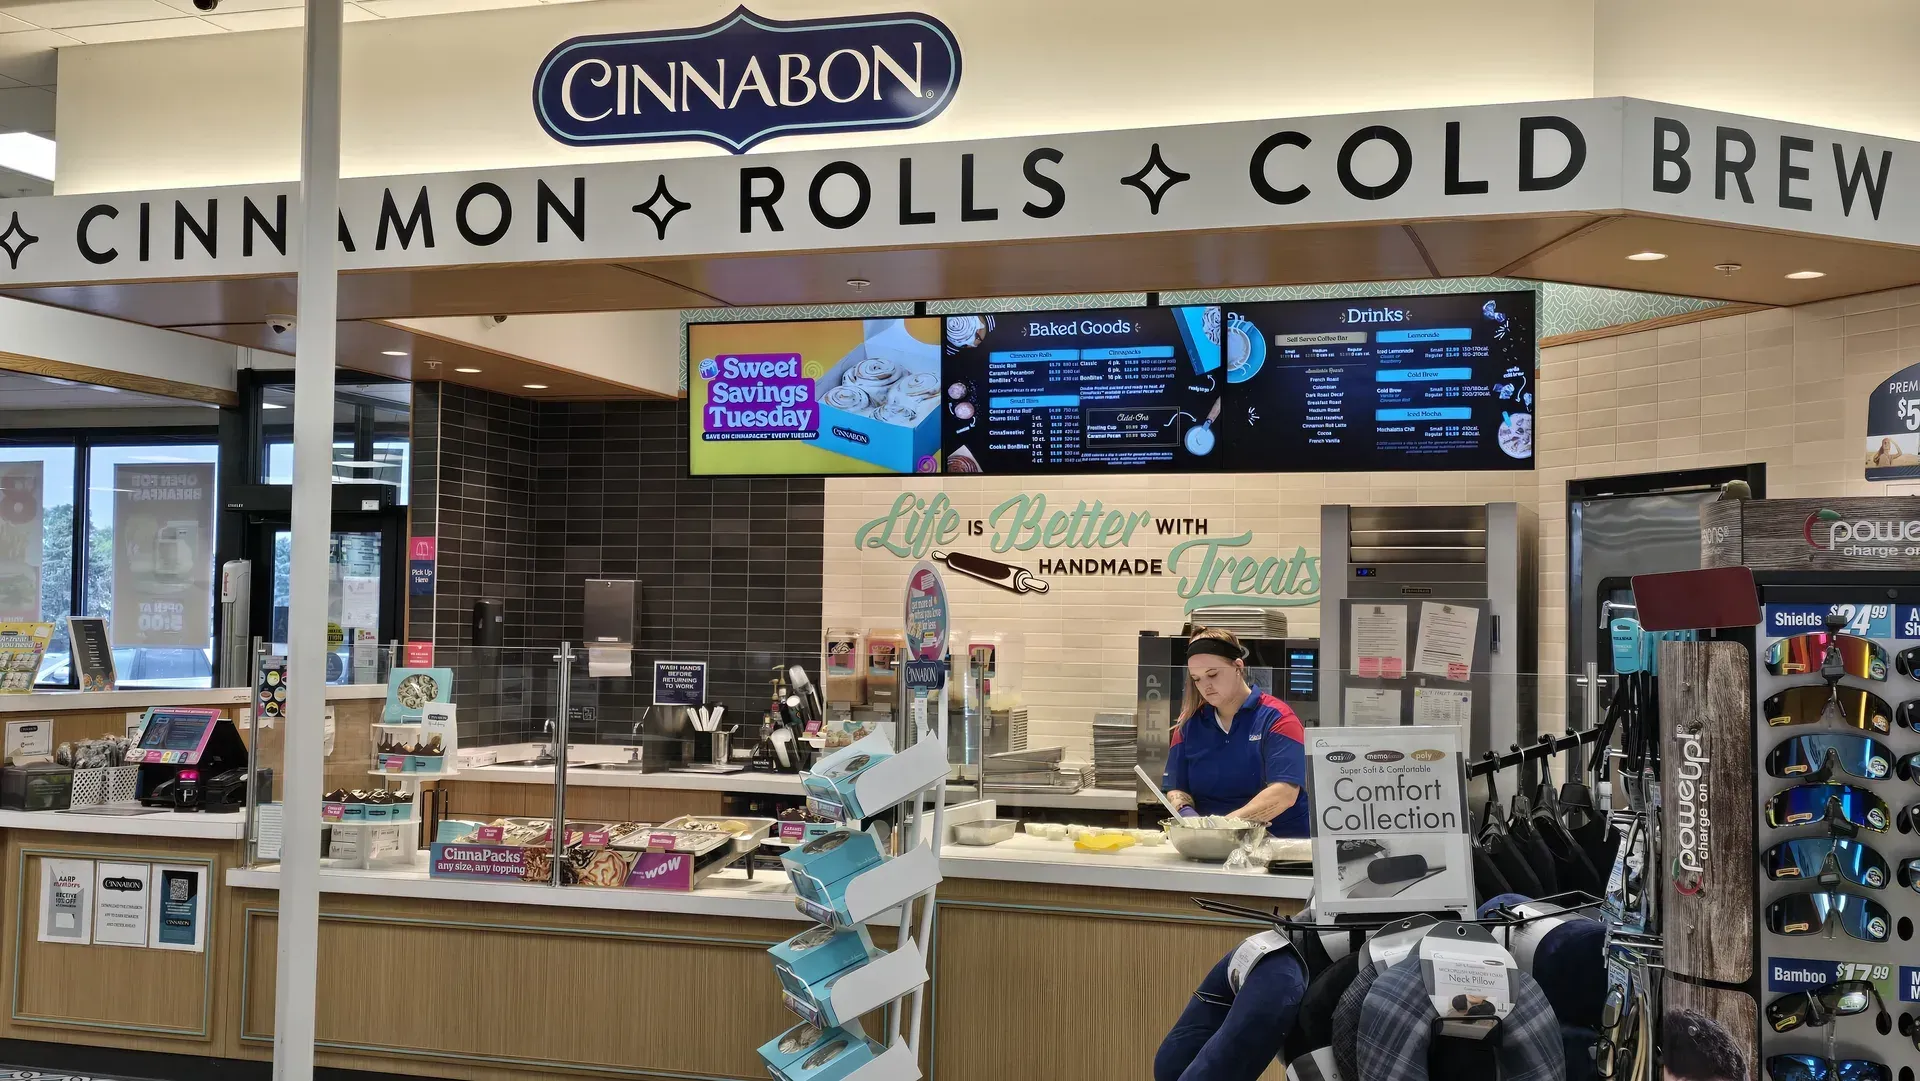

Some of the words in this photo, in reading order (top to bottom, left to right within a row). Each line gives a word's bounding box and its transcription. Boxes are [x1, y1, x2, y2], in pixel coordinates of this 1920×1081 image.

[561, 42, 923, 122] CINNABON
[739, 147, 1067, 234] ROLLS
[1249, 115, 1587, 205] COLD
[1653, 117, 1893, 221] BREW
[1347, 308, 1403, 323] Drinks
[1029, 321, 1077, 337] Baked
[1080, 320, 1130, 335] Goods
[723, 357, 798, 379] Sweet
[712, 381, 808, 407] Savings
[709, 404, 812, 431] Tuesday
[772, 432, 789, 440] EVERY
[790, 432, 816, 440] TUESDAY
[833, 428, 867, 443] CINNABON
[855, 491, 960, 559] Life
[967, 520, 984, 536] IS
[988, 492, 1151, 554] Better
[1155, 518, 1209, 536] WITH
[1844, 546, 1898, 558] charge
[423, 569, 433, 577] Up
[1039, 557, 1163, 576] HANDMADE
[1168, 530, 1320, 604] Treats
[415, 576, 429, 584] Here
[917, 601, 927, 609] more
[926, 599, 933, 607] of
[924, 612, 932, 621] you
[1775, 612, 1822, 626] Shields
[927, 620, 936, 630] less
[906, 665, 936, 683] CINNABON
[1340, 767, 1361, 775] Super
[1334, 774, 1442, 802] Comfort
[1699, 783, 1708, 802] on
[1322, 803, 1456, 831] Collection
[1699, 808, 1711, 860] charge
[444, 847, 522, 863] CinnaPacks
[437, 863, 454, 872] any
[455, 862, 473, 873] size,
[474, 864, 491, 874] any
[493, 864, 526, 876] topping
[645, 856, 682, 879] WOW
[104, 878, 141, 889] CINNABON
[1448, 974, 1470, 984] Neck
[1472, 976, 1496, 986] Pillow
[1774, 966, 1827, 984] Bamboo
